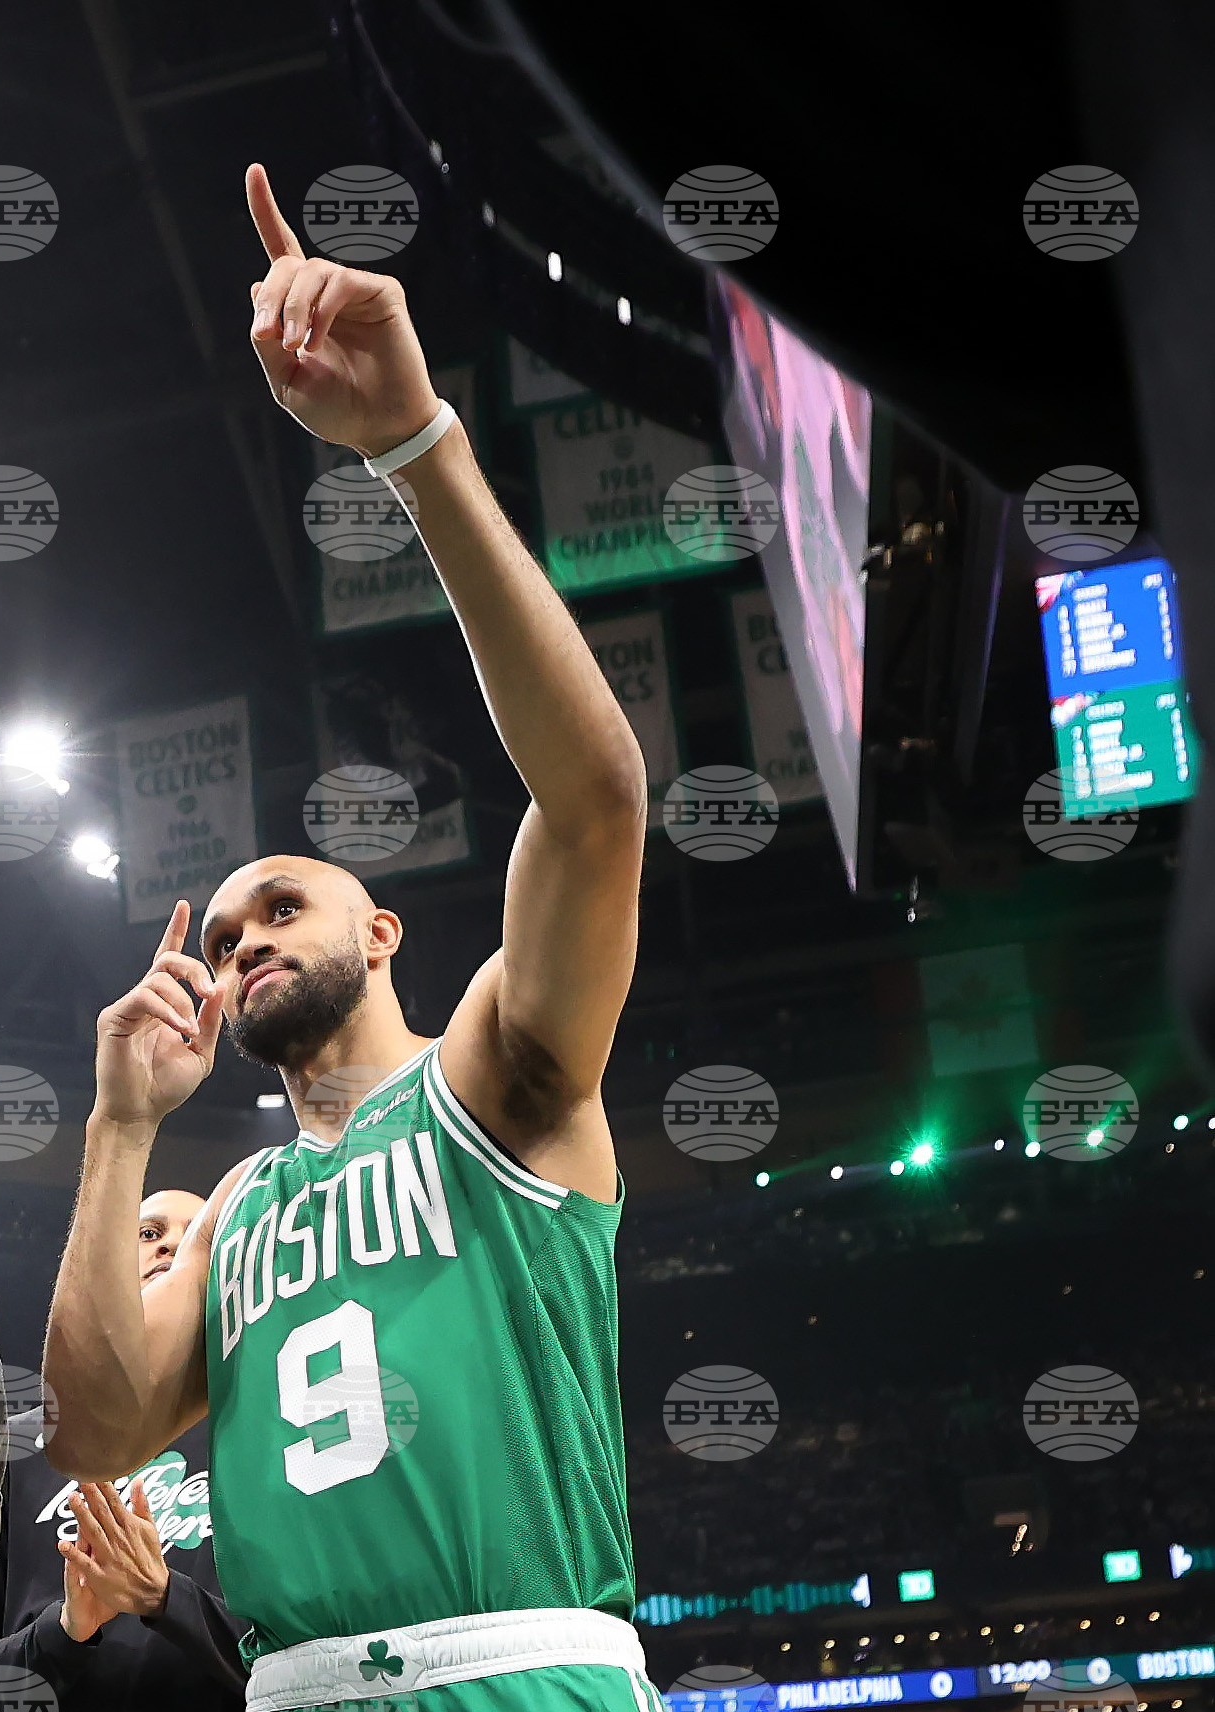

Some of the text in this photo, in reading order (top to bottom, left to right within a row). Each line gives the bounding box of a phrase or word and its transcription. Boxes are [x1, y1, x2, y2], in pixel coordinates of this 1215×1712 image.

[219, 1130, 458, 1362] BOSTON
[276, 1298, 390, 1496] 9
[776, 1647, 1214, 1711] PHILADELPHIA 0 12:00 0 BOSTON
